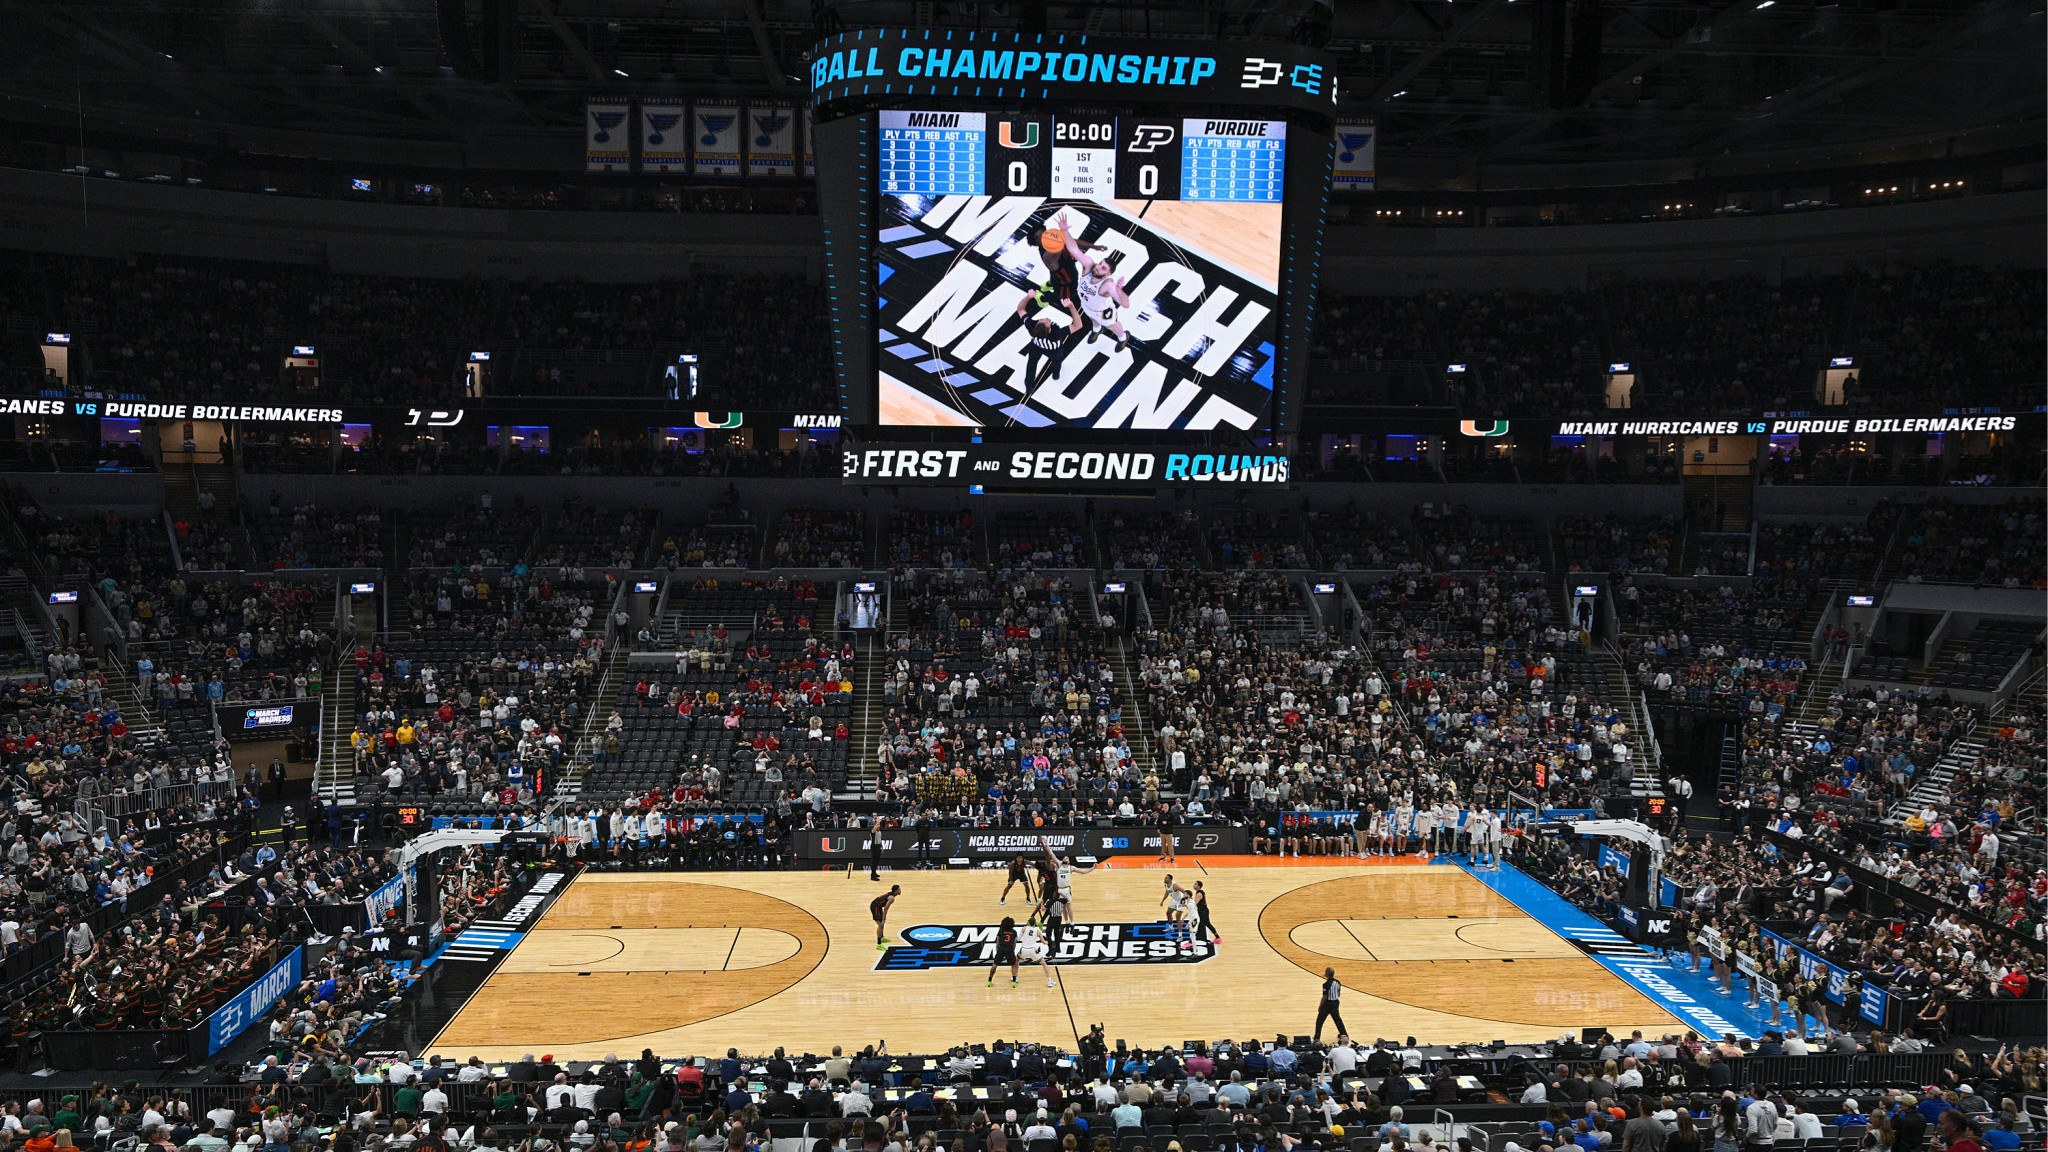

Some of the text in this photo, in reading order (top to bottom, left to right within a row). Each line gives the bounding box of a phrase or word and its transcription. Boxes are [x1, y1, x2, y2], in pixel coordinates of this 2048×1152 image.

[898, 47, 1217, 86] CHAMPIONSHIP
[908, 113, 960, 128] MIAMI
[1056, 123, 1112, 141] 20:00
[1204, 121, 1268, 136] PURDUE
[885, 131, 979, 141] PLY PTS REB AST FLS
[890, 141, 896, 150] 3
[1188, 139, 1203, 147] PLY
[1207, 140, 1222, 148] PTS
[1227, 140, 1241, 148] REB
[1246, 140, 1260, 148] AST
[890, 151, 896, 160] 5
[1076, 153, 1091, 162] 1ST
[1192, 149, 1199, 157] 0
[890, 161, 896, 170] 7
[1192, 159, 1198, 168] 2
[890, 171, 896, 180] 8
[1008, 161, 1028, 192] 0
[1191, 169, 1198, 178] 3
[1139, 164, 1159, 195] 0
[1191, 179, 1197, 188] 4
[887, 182, 898, 191] 35
[1188, 189, 1199, 198] 45
[75, 403, 97, 416] VS
[105, 402, 186, 419] PURDUE
[192, 405, 343, 422] BOILERMAKERS
[1559, 416, 2016, 435] MIAMI HURRICANES VS PURDUE BOILERMAKERS
[862, 450, 1288, 484] FIRST AND SECOND ROUNDS
[258, 715, 291, 724] MADNESS
[1651, 805, 1661, 814] 30
[403, 814, 414, 824] 30
[862, 840, 893, 850] MMI
[968, 836, 995, 846] NCAA
[998, 835, 1038, 846] SECOND
[1144, 837, 1180, 847] PURE
[502, 895, 545, 921] SECOND
[1004, 934, 1010, 942] 3
[979, 940, 1208, 960] MDNESS
[250, 959, 291, 1019] MARCH
[1623, 967, 1696, 1003] SECOND
